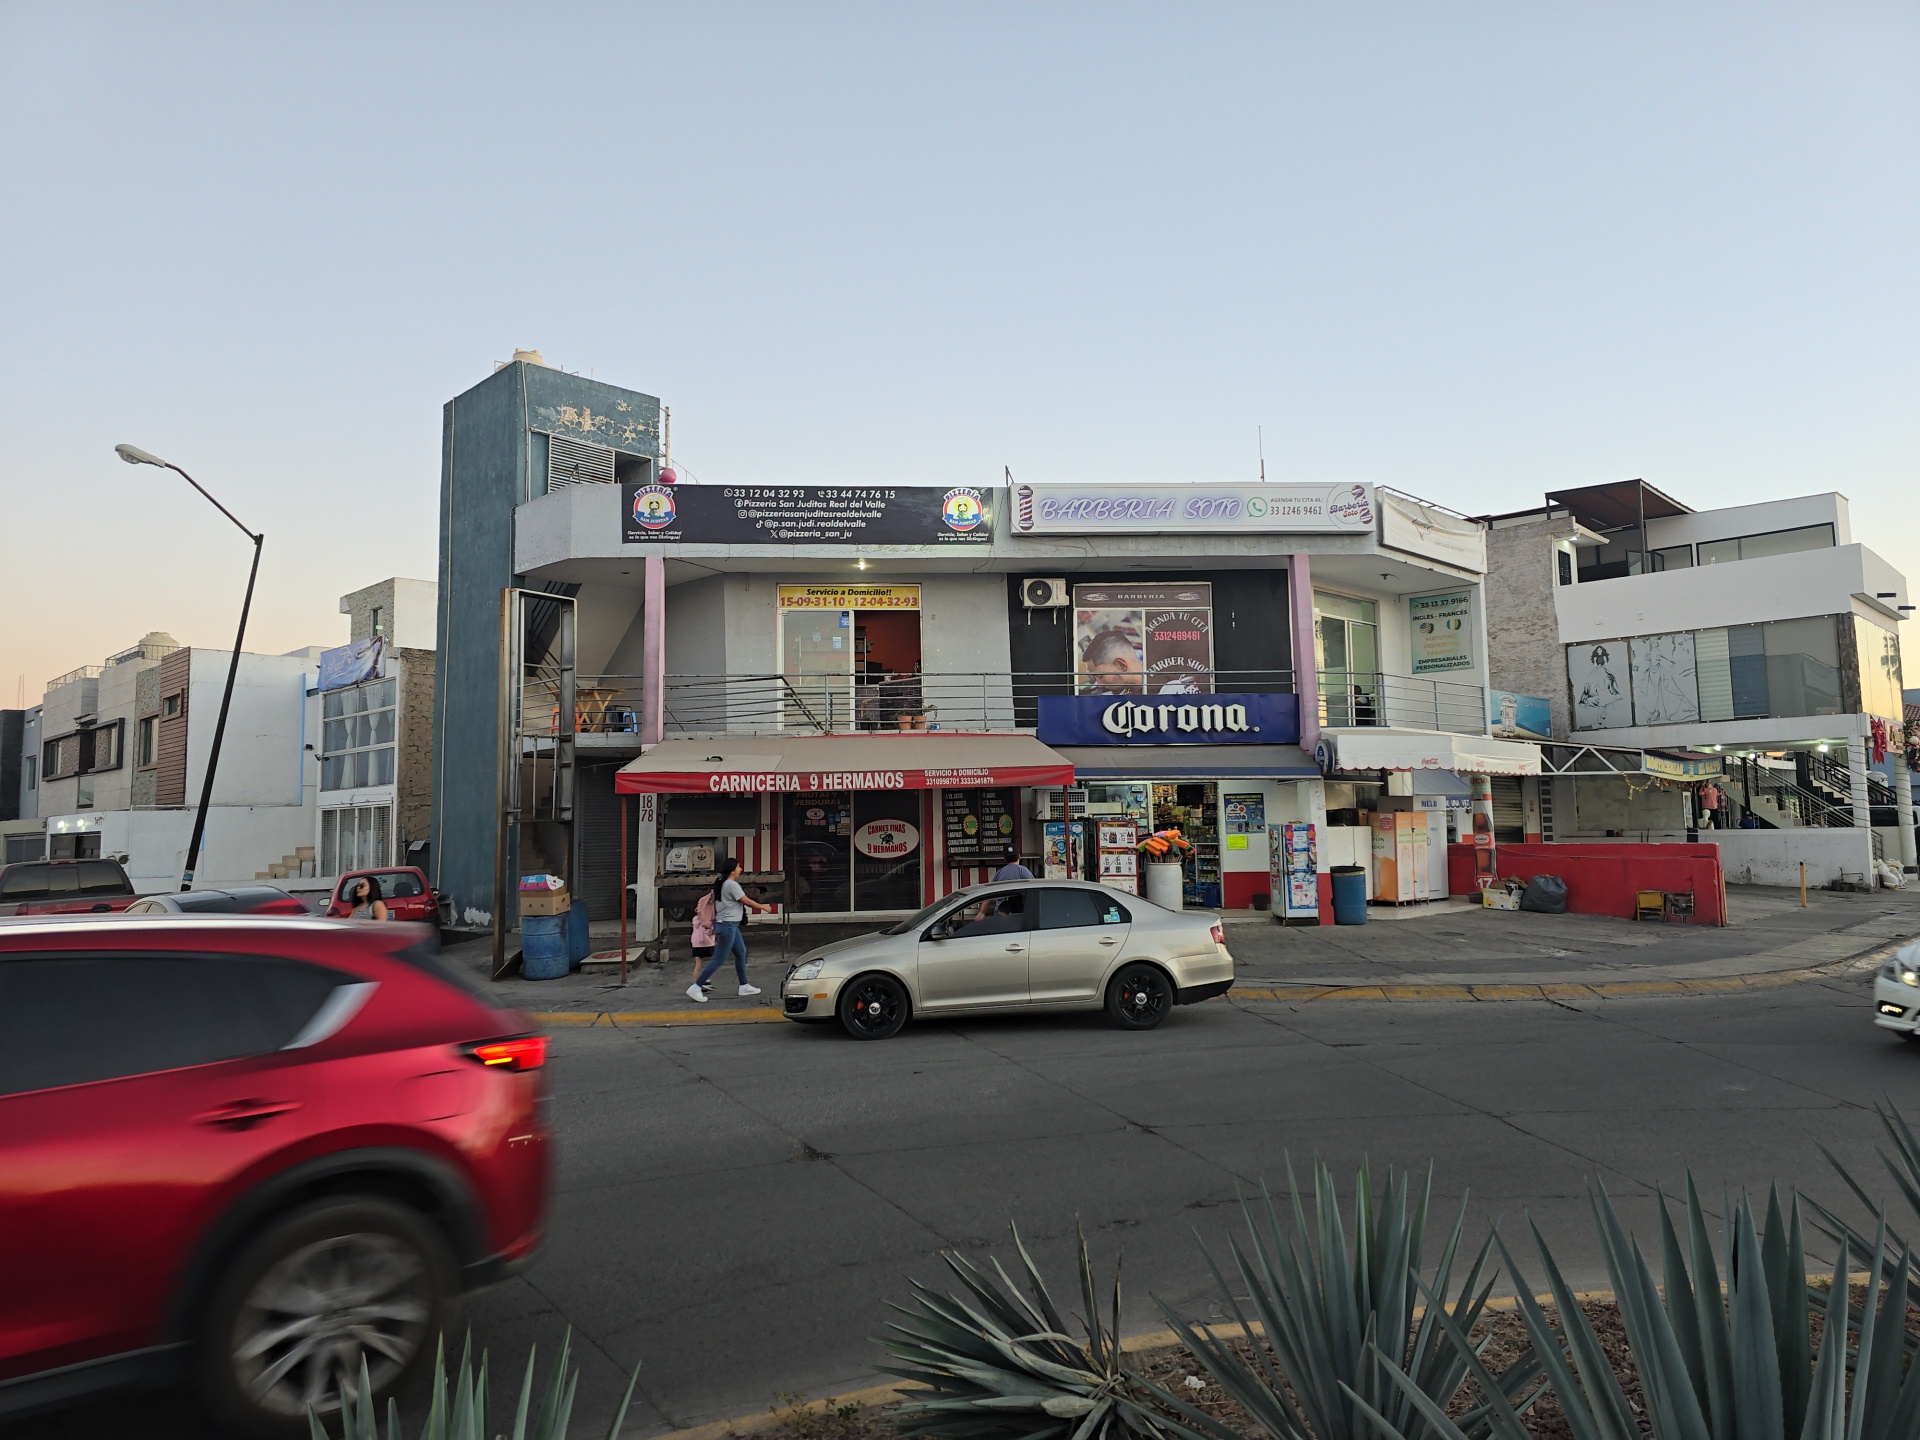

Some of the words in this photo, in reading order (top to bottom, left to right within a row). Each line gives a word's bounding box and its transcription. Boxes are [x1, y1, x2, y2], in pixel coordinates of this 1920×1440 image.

[734, 489, 746, 498] 33
[749, 489, 760, 498] 12
[763, 489, 775, 498] 04
[778, 489, 790, 498] 32
[792, 489, 805, 498] 93
[825, 489, 838, 499] 33
[840, 489, 852, 499] 44
[855, 489, 867, 499] 74
[870, 489, 881, 499] 76
[884, 489, 896, 499] 15
[744, 500, 777, 509] Pizzeria
[779, 500, 795, 509] San
[797, 500, 827, 509] Juditas
[829, 500, 847, 509] Real
[849, 500, 863, 509] del
[865, 500, 886, 509] Valle
[1039, 498, 1176, 520] BARBERIA
[1183, 497, 1243, 520] SOTO
[1270, 506, 1280, 515] 33
[1282, 506, 1301, 515] 1246
[1303, 506, 1322, 515] 9461
[779, 529, 852, 540] @pizzeria_san_ju
[847, 588, 892, 596] Domicilio!!
[780, 596, 846, 607] 15-09-31-10
[854, 597, 918, 607] 12-04-32-93
[1431, 600, 1438, 608] 13
[1451, 596, 1468, 605] 9166
[1145, 612, 1176, 634] AGENDA
[1178, 611, 1190, 621] TU
[1190, 616, 1209, 633] CITA
[1154, 631, 1200, 641] 3312469461
[1418, 655, 1467, 665] EMPRESARIALES
[1416, 661, 1470, 671] PERSONALIZADOS
[1102, 700, 1250, 738] Corona
[924, 769, 952, 777] SERVICIO
[953, 769, 958, 777] A
[959, 768, 989, 776] DOMICILIO
[709, 774, 801, 792] CARNICERIA
[810, 773, 819, 791] 9
[823, 772, 904, 790] HERMANOS
[642, 795, 653, 809] 18
[641, 809, 654, 822] 78
[867, 824, 889, 835] CARNES
[890, 823, 906, 834] FINAS
[867, 843, 872, 854] 9
[873, 841, 908, 854] HERMANOS
